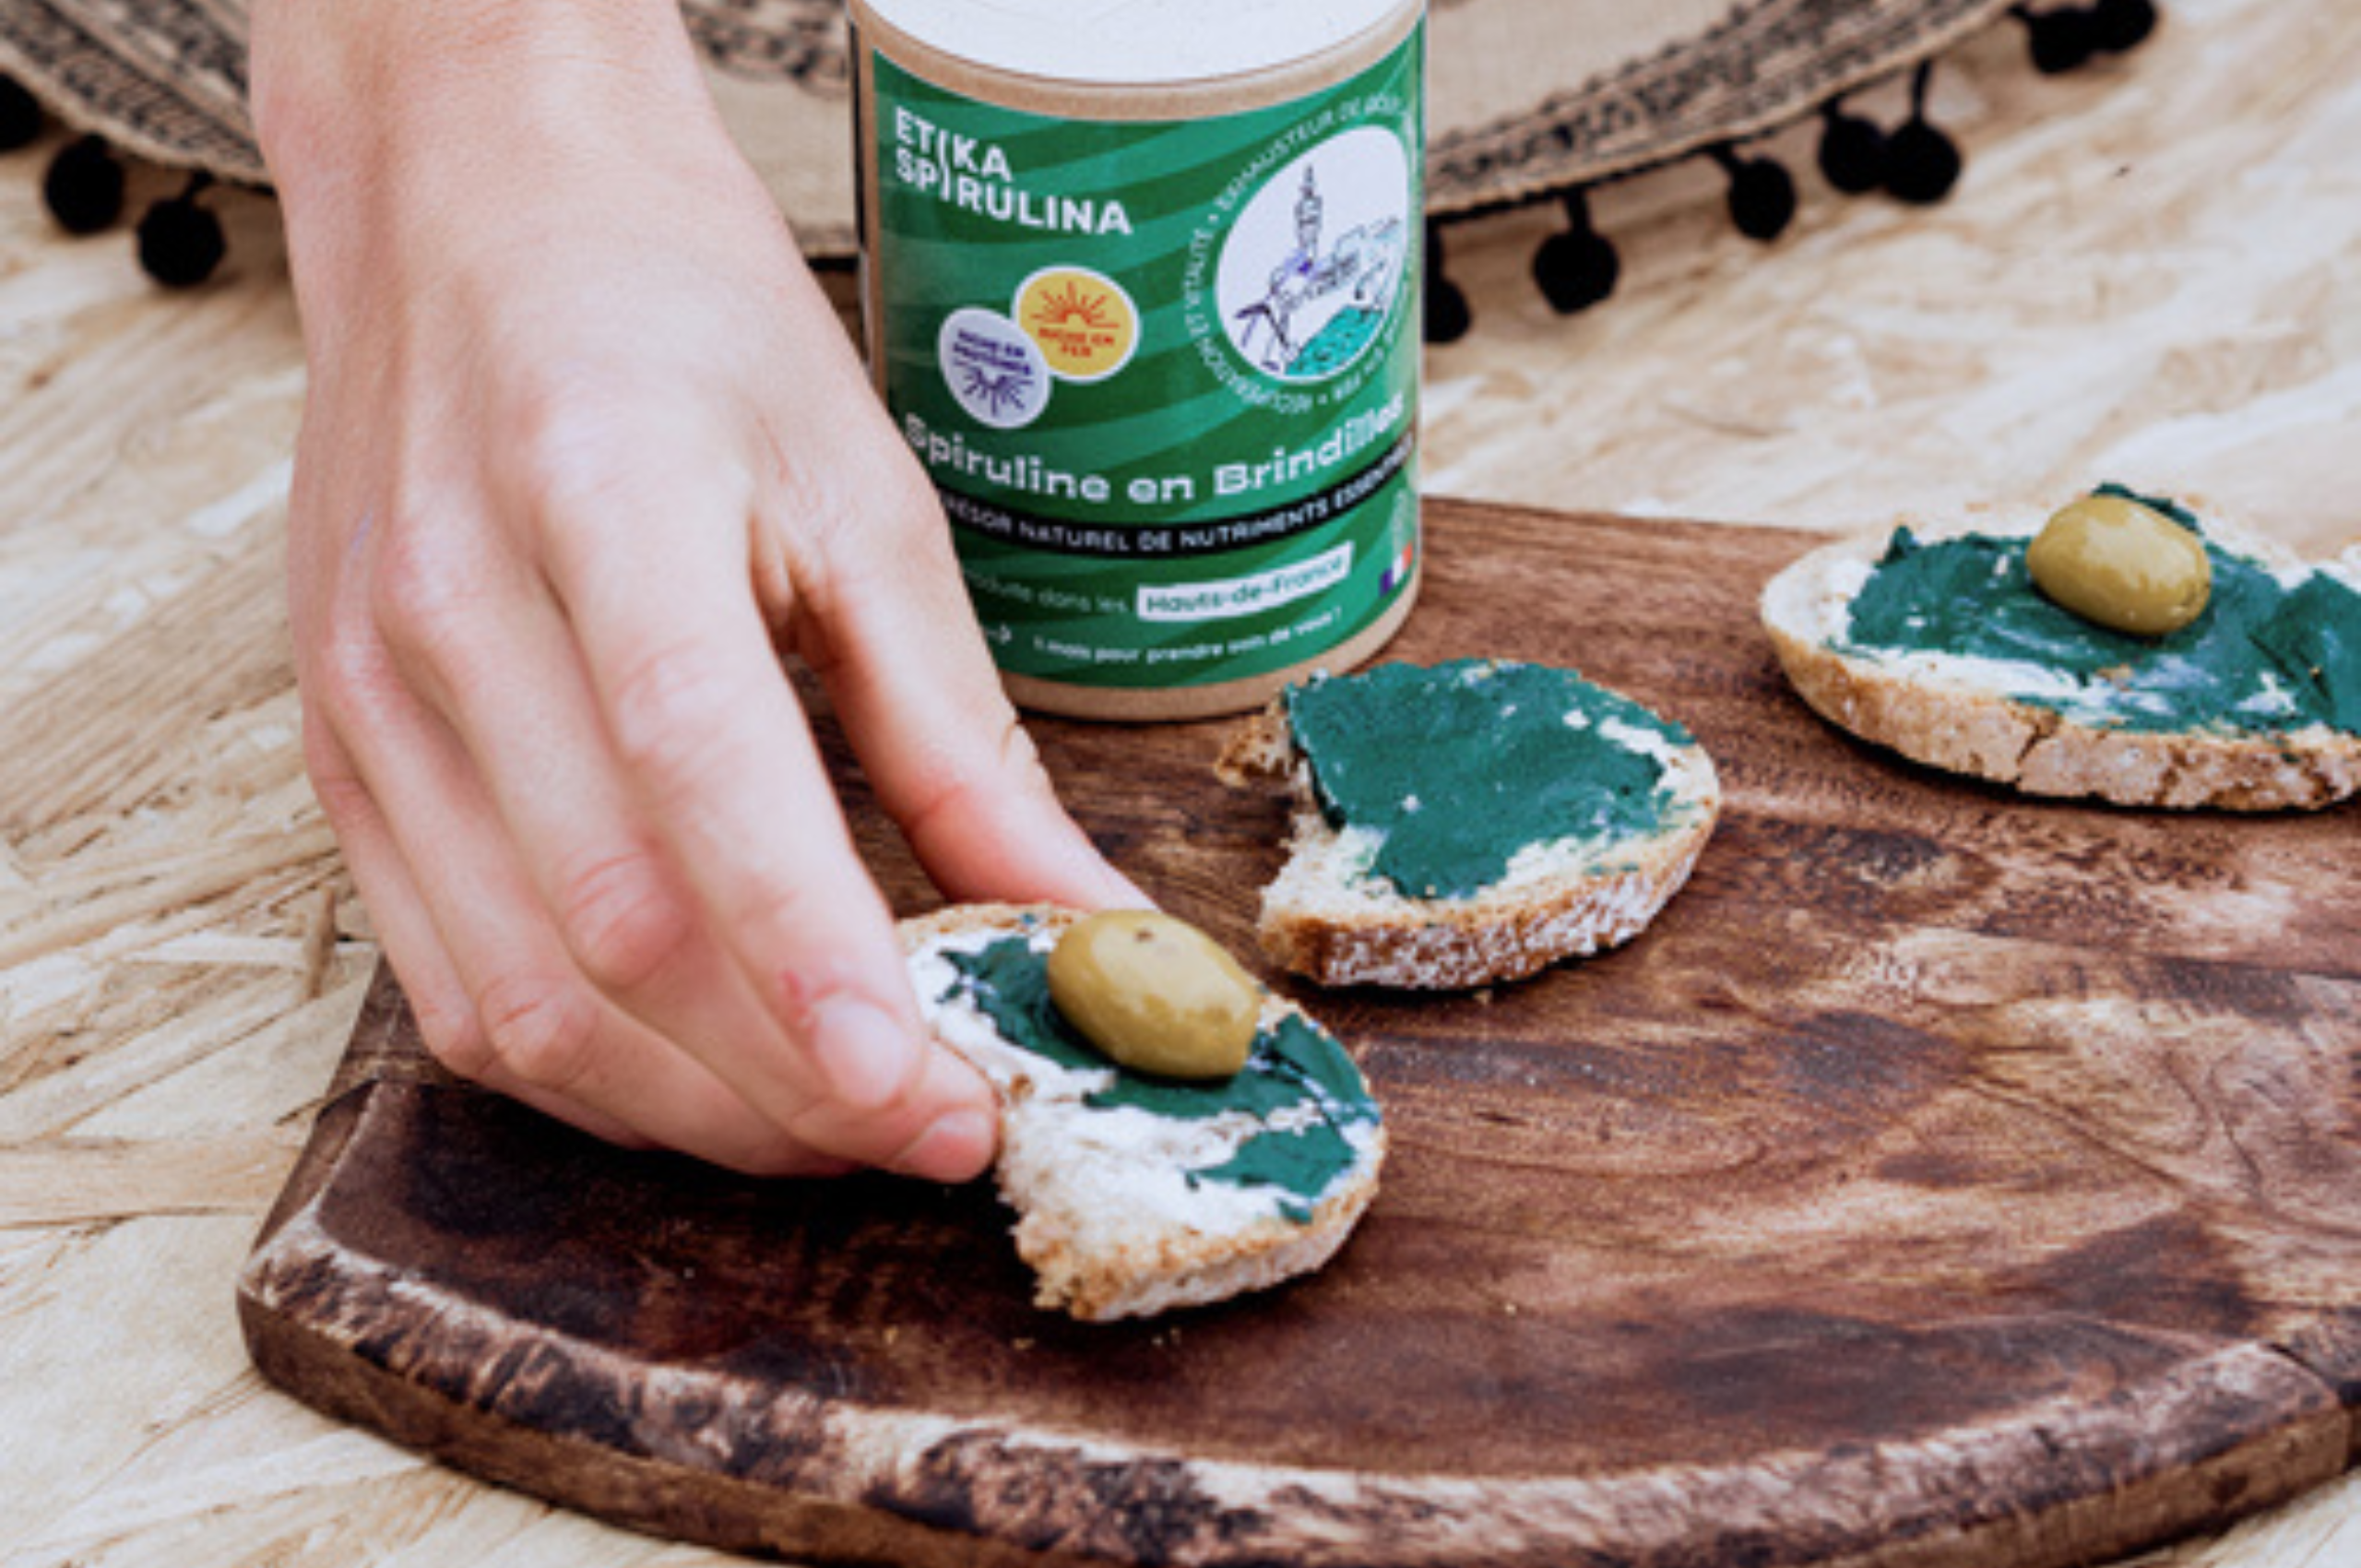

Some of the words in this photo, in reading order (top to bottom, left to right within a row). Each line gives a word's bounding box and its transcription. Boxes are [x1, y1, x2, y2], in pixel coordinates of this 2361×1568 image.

[896, 106, 1014, 183] ETIKA
[896, 146, 1133, 236] SPIRULINA
[906, 412, 1109, 504] Spiruline
[1127, 476, 1194, 504] en
[1213, 391, 1403, 495] Brindilles
[1019, 518, 1130, 552] NATUREL
[1137, 529, 1172, 552] DE
[1180, 497, 1329, 548] NUTRIMENTS
[1146, 552, 1344, 614] Hauts-de-France
